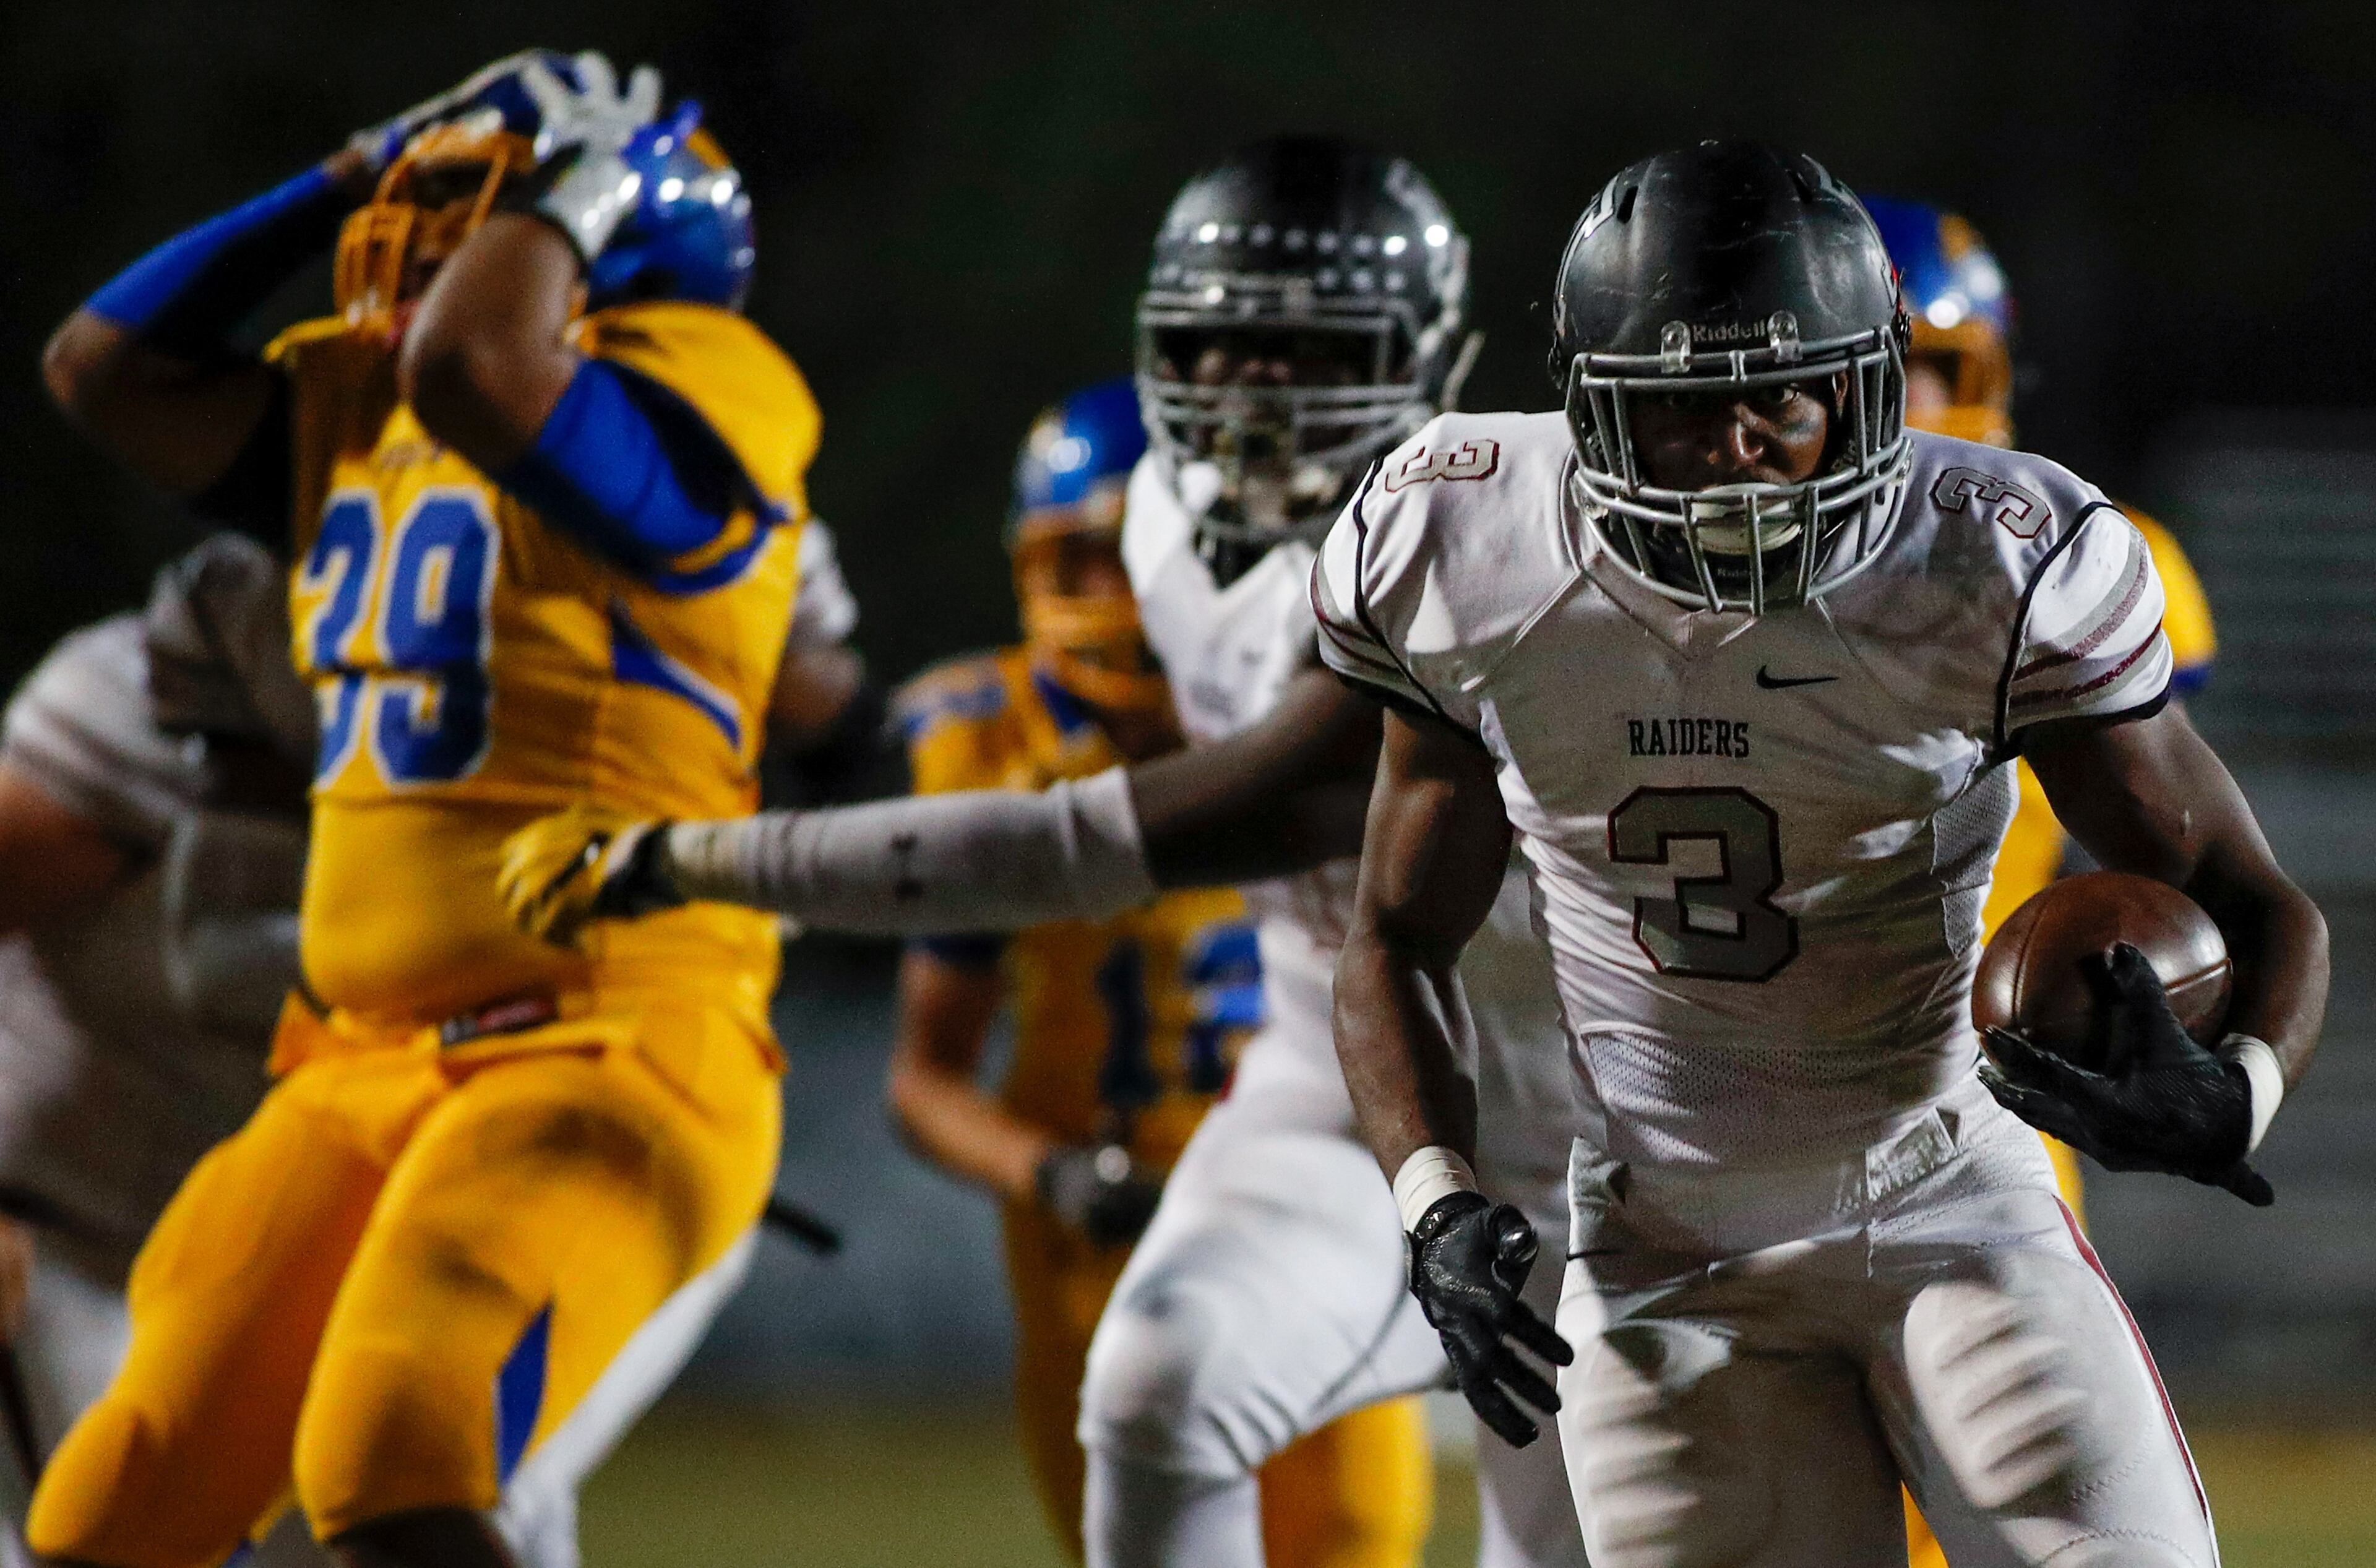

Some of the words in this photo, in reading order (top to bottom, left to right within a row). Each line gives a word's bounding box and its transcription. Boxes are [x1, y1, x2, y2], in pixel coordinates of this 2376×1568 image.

[1385, 438, 1500, 493] 3
[1929, 467, 2052, 540] 3
[1627, 718, 1751, 759] RAIDERS
[1608, 785, 1800, 984] 3
